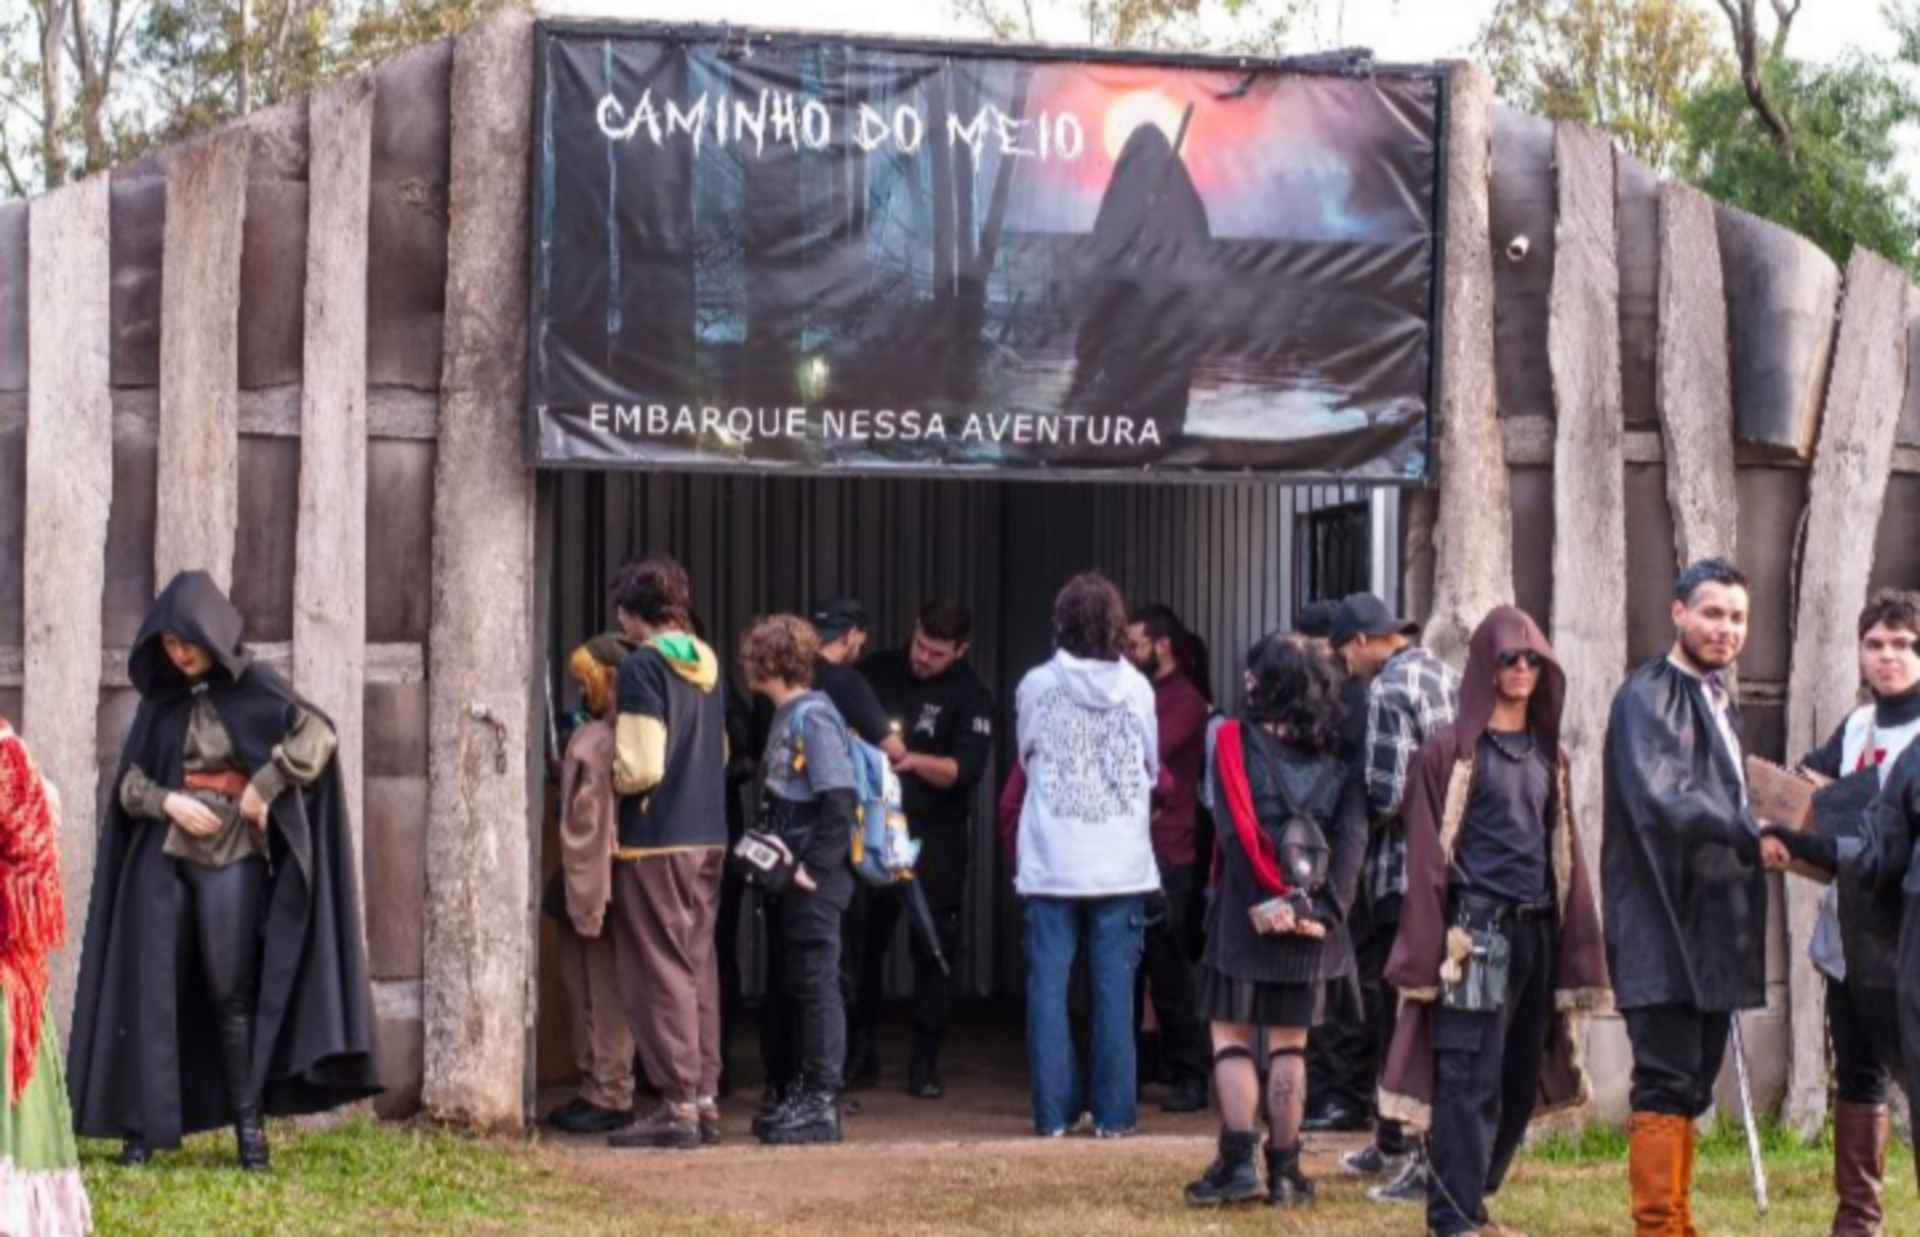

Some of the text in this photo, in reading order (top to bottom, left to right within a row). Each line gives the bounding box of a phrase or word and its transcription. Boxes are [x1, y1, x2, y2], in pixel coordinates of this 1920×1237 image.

[596, 88, 1085, 170] CAMINHO DO MEIO
[590, 404, 1162, 446] EMBARQUE NESSA AVENTURA
